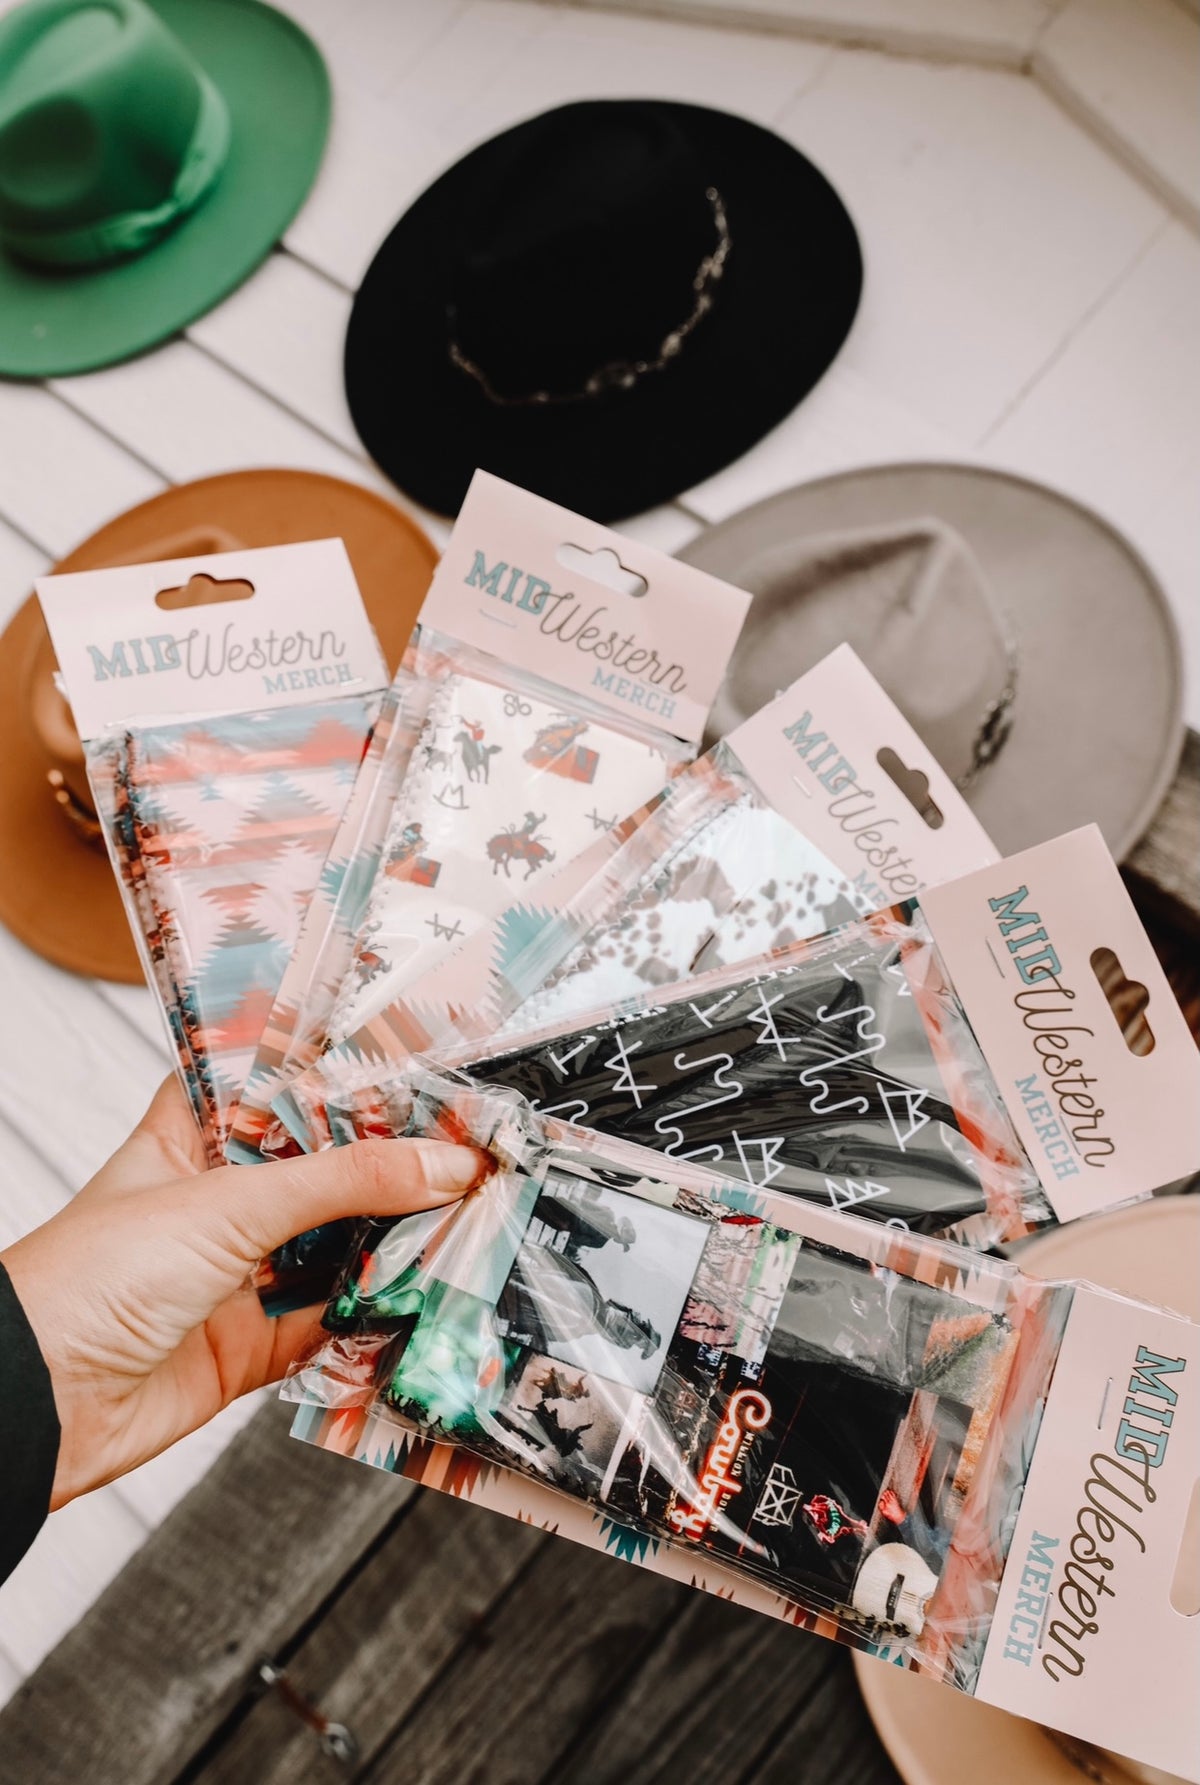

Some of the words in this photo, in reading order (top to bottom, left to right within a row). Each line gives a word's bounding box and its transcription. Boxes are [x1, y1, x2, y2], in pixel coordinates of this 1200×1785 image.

[262, 663, 353, 694] MERCH
[591, 667, 678, 719] MERCH
[1014, 1073, 1080, 1181] MERCH
[1003, 1530, 1060, 1667] MERCH
